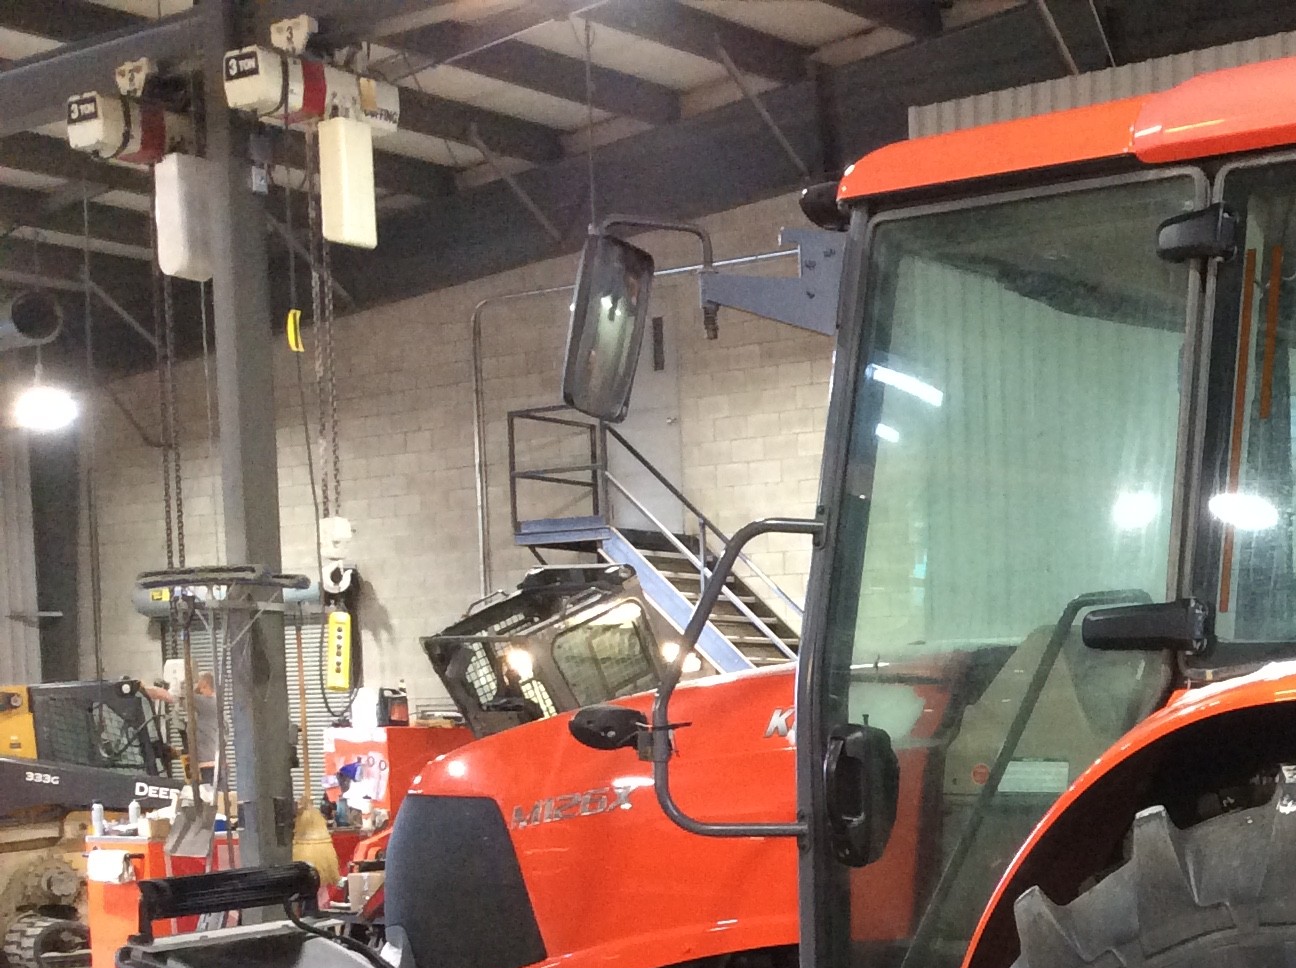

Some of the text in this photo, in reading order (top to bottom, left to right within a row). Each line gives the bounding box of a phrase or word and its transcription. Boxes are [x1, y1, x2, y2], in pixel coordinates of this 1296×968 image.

[228, 57, 256, 76] 3 TON
[70, 101, 96, 120] 3 TON
[25, 771, 60, 785] 333G
[134, 781, 181, 800] DEER
